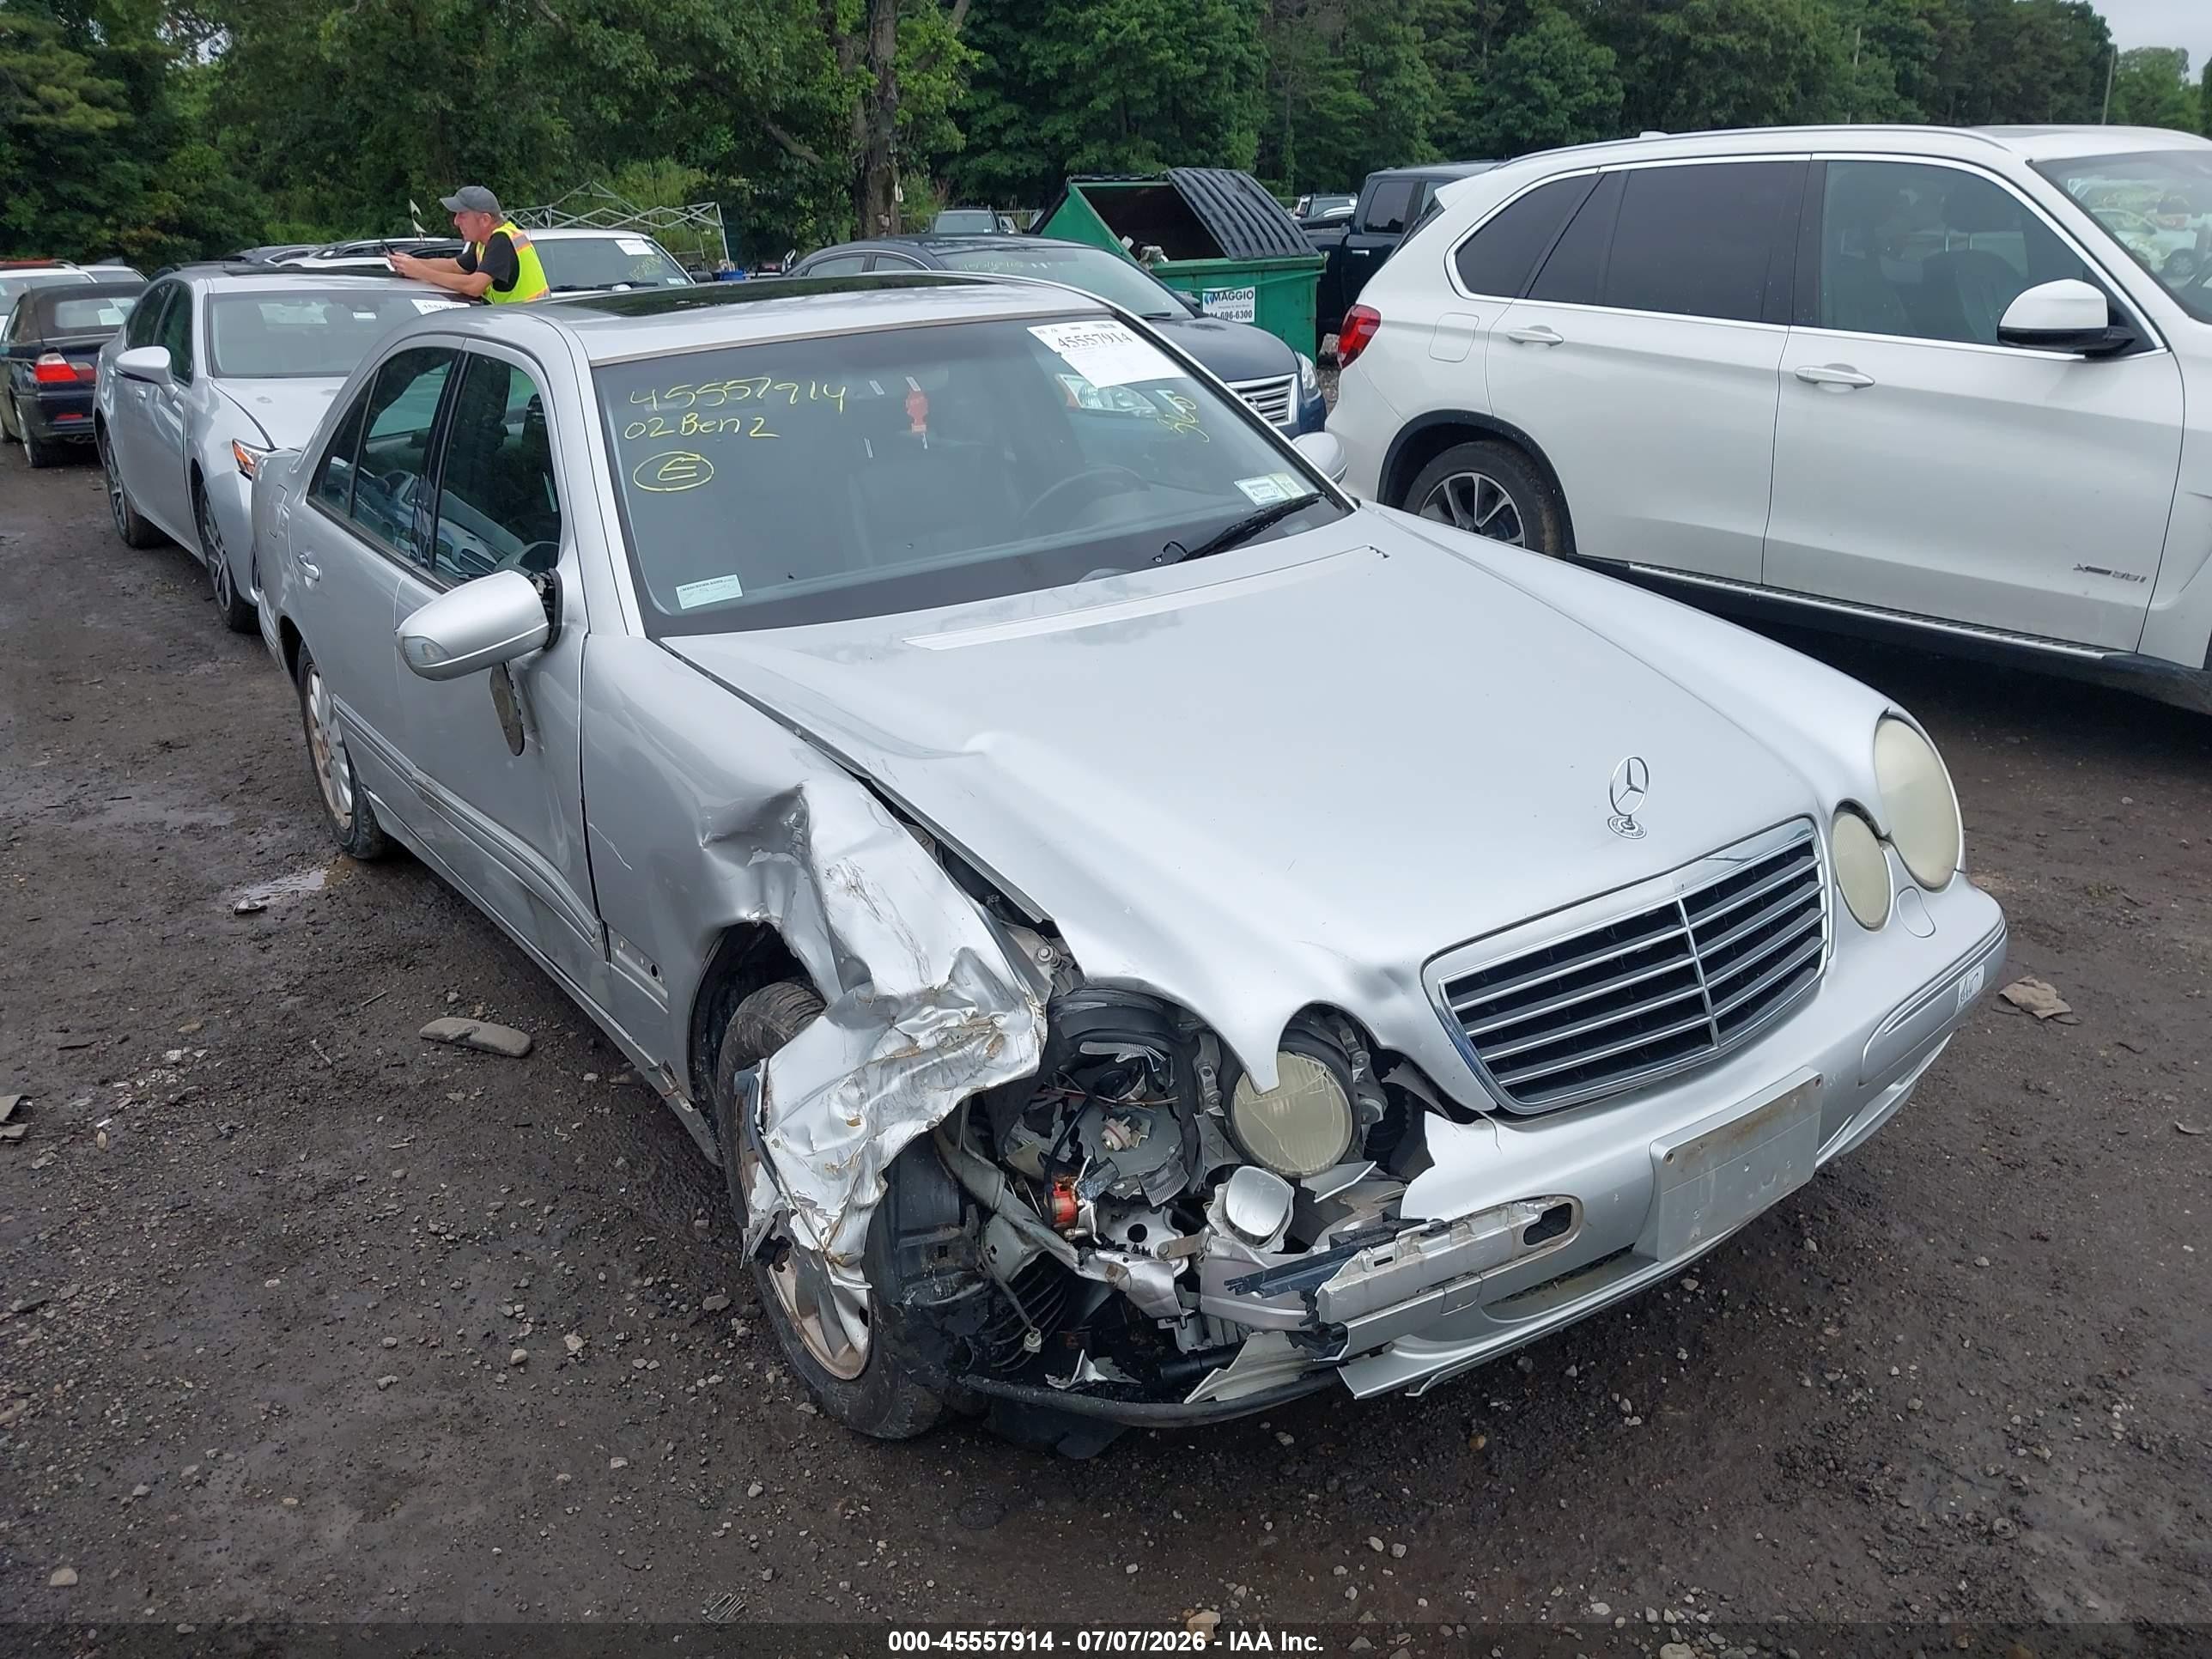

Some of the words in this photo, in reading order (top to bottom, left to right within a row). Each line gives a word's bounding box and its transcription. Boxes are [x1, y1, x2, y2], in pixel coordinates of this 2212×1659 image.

[1212, 289, 1255, 302] MAGGIO
[1206, 309, 1253, 321] -696-6300
[1057, 331, 1133, 349] 45557914
[629, 377, 847, 415] 45557914
